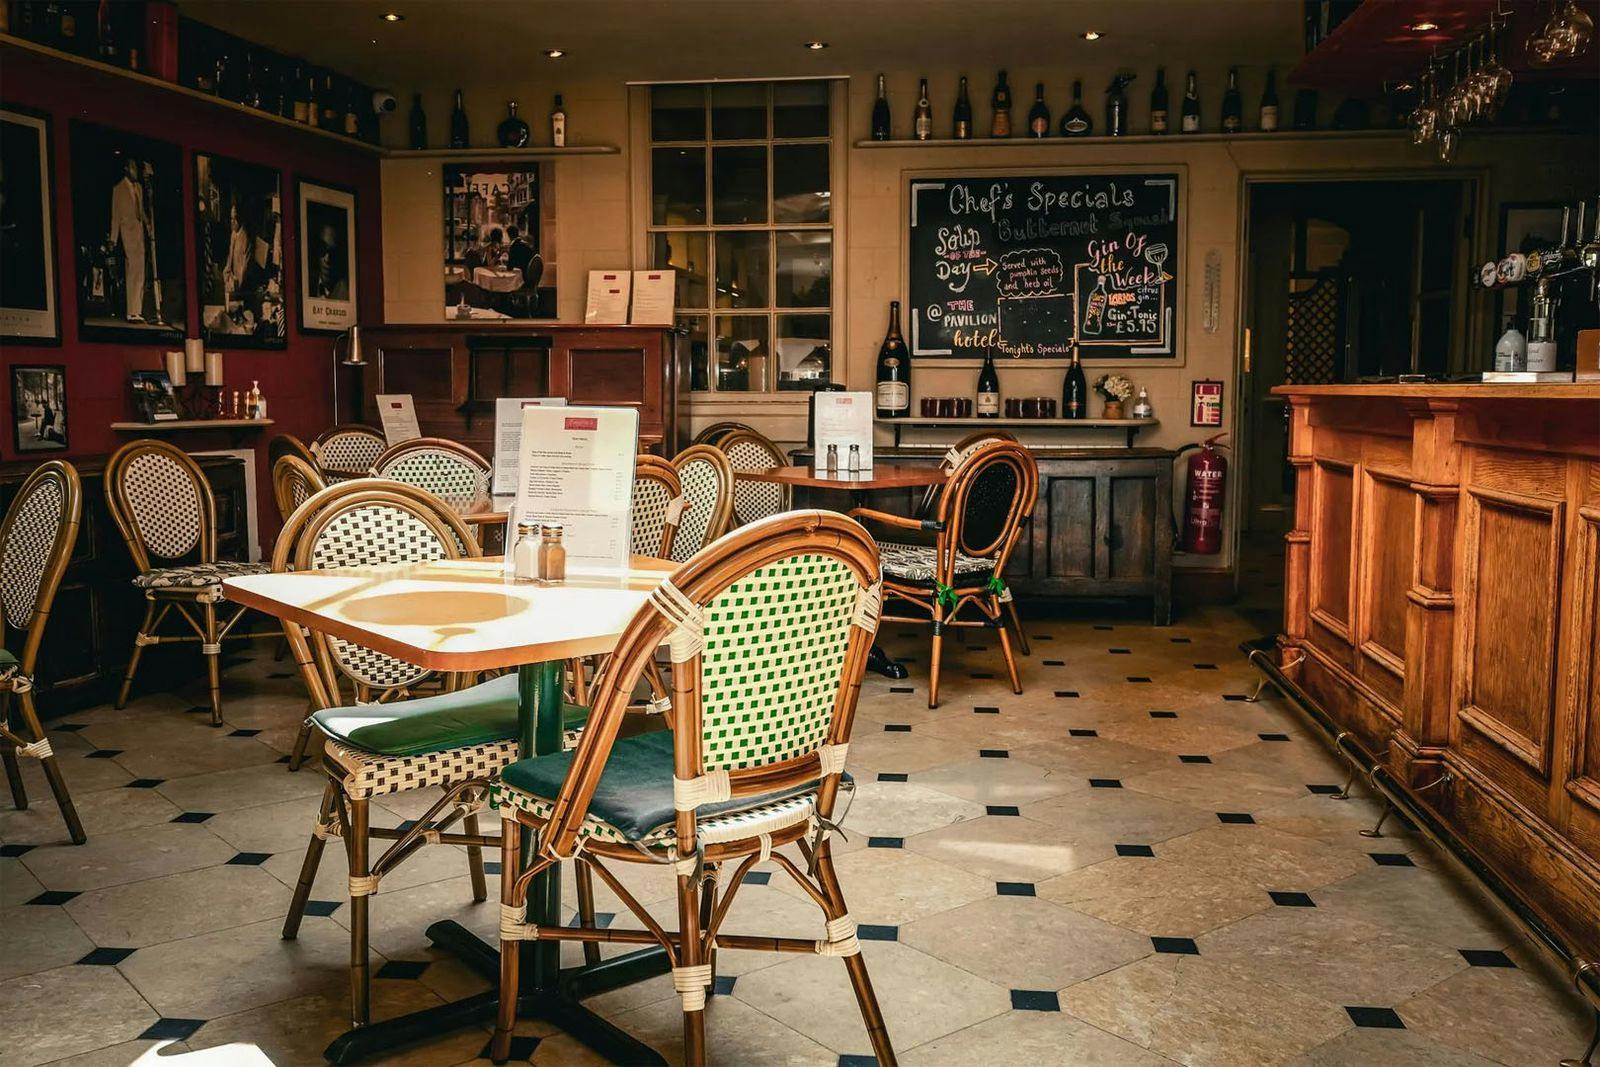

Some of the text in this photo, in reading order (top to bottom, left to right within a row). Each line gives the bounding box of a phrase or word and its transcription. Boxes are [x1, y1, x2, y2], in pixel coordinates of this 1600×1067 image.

[950, 181, 1134, 223] Chef's Specials
[935, 224, 981, 256] Soup
[1088, 239, 1120, 267] Gin
[1002, 257, 1047, 270] Served with
[1101, 254, 1124, 275] the
[936, 260, 972, 293] Day
[1010, 268, 1038, 281] pumpkin
[1043, 276, 1054, 288] oil
[1114, 266, 1155, 287] Week
[947, 300, 975, 312] THE
[944, 313, 998, 328] PAVILION
[953, 328, 998, 348] hotel
[1000, 342, 1070, 359] Tonight's Specials
[1194, 469, 1223, 478] WATER
